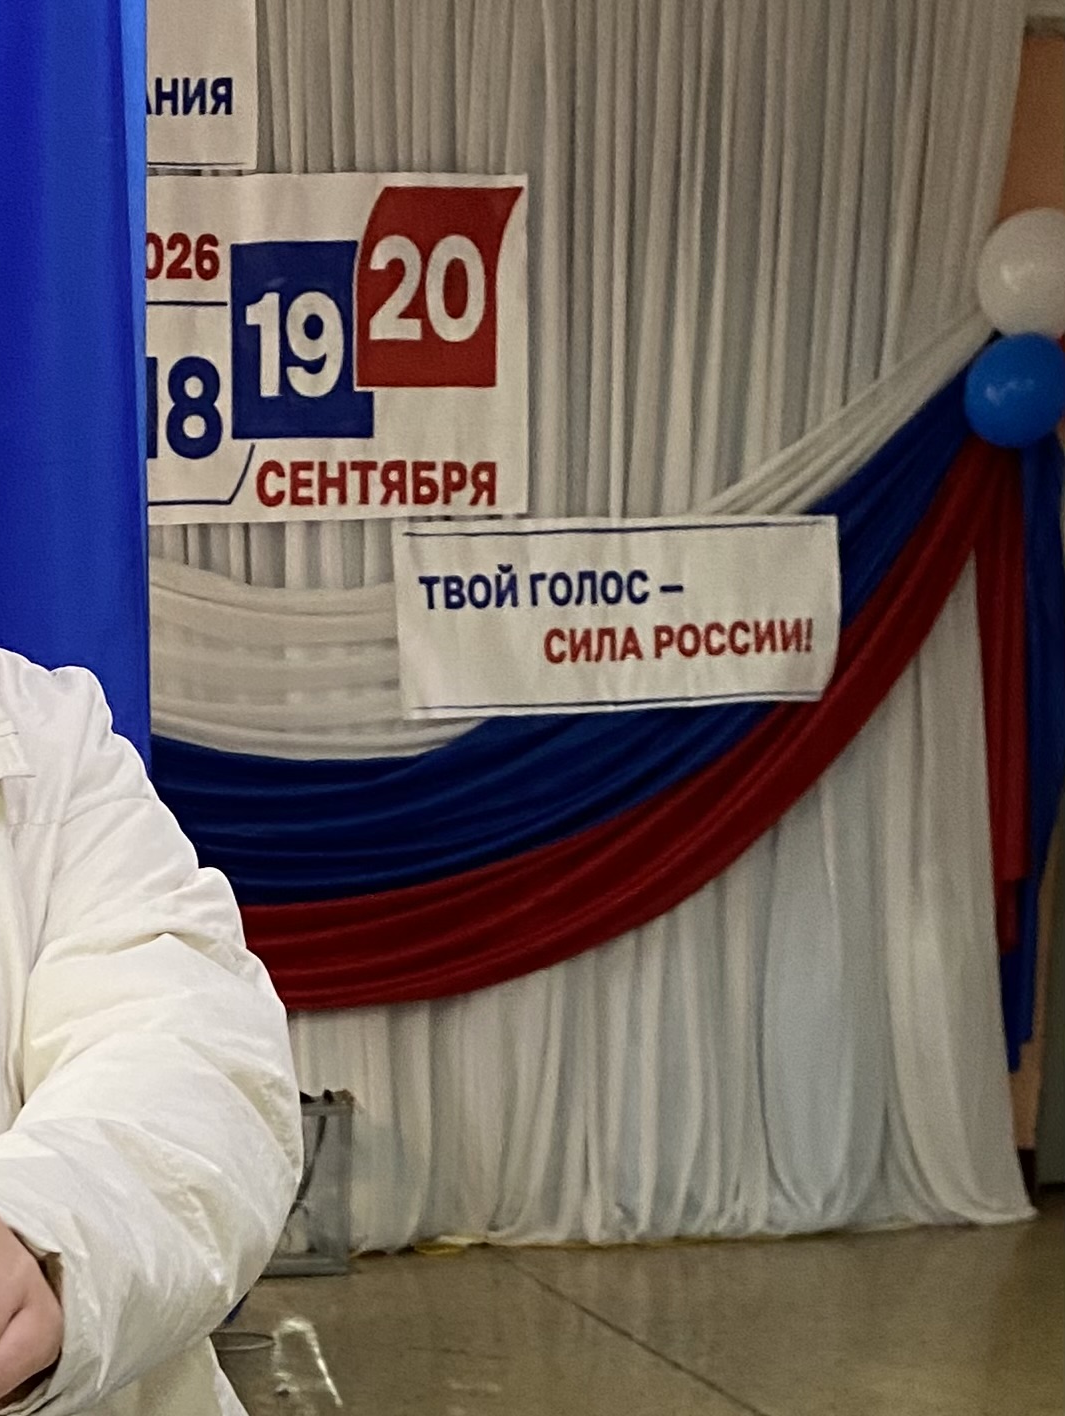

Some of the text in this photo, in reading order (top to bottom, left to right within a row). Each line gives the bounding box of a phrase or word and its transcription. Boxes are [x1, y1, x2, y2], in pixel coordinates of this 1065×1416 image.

[146, 77, 233, 116] НИЯ
[245, 291, 345, 398] 19
[368, 234, 486, 342] 20
[255, 460, 497, 507] СЕНТЯБРЯ
[418, 563, 518, 610] ТВОЙ
[529, 569, 650, 607] ГОЛОС
[543, 618, 813, 664] СИЛА РОССИИ!
